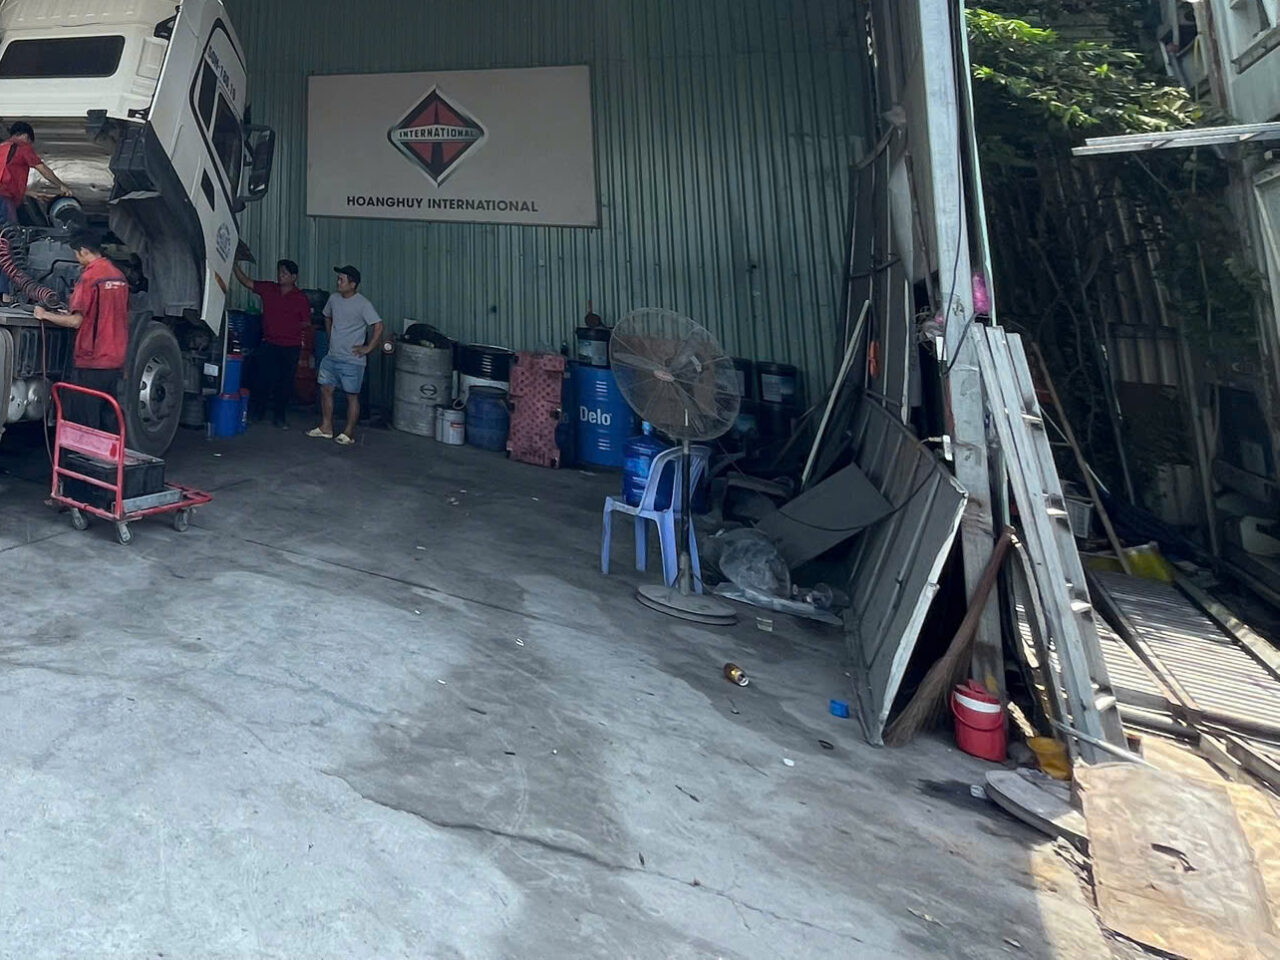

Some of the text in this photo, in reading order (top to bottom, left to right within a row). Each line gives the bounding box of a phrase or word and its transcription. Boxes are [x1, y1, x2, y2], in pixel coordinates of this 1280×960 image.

[399, 126, 474, 139] INTERNATIONAL
[346, 195, 539, 213] HOANGHUY INTERNATIONAL
[580, 405, 611, 426] Delo
